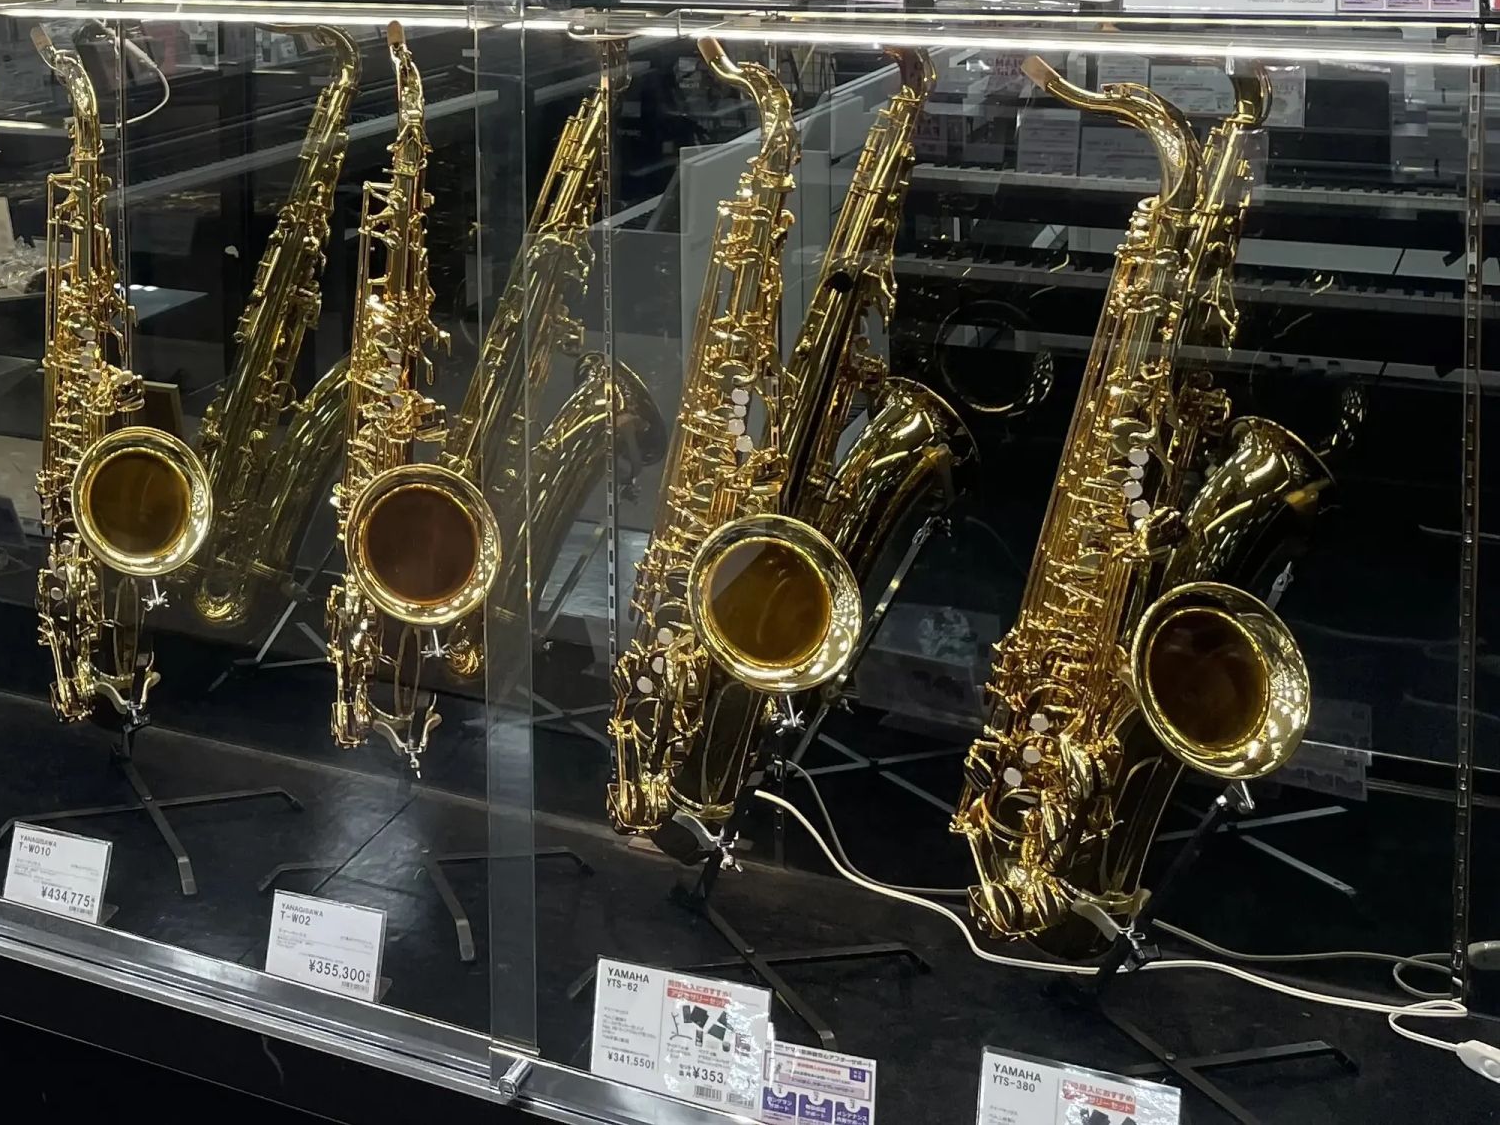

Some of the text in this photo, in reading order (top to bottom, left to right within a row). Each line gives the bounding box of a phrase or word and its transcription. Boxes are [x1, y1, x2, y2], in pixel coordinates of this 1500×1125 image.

[281, 902, 324, 917] YANAGISAWA
[308, 958, 366, 983] ¥355,300
[607, 967, 650, 984] YAMAHA
[606, 978, 639, 993] YTS-62
[993, 1062, 1042, 1083] YAMAHA
[991, 1074, 1036, 1093] YTS-380
